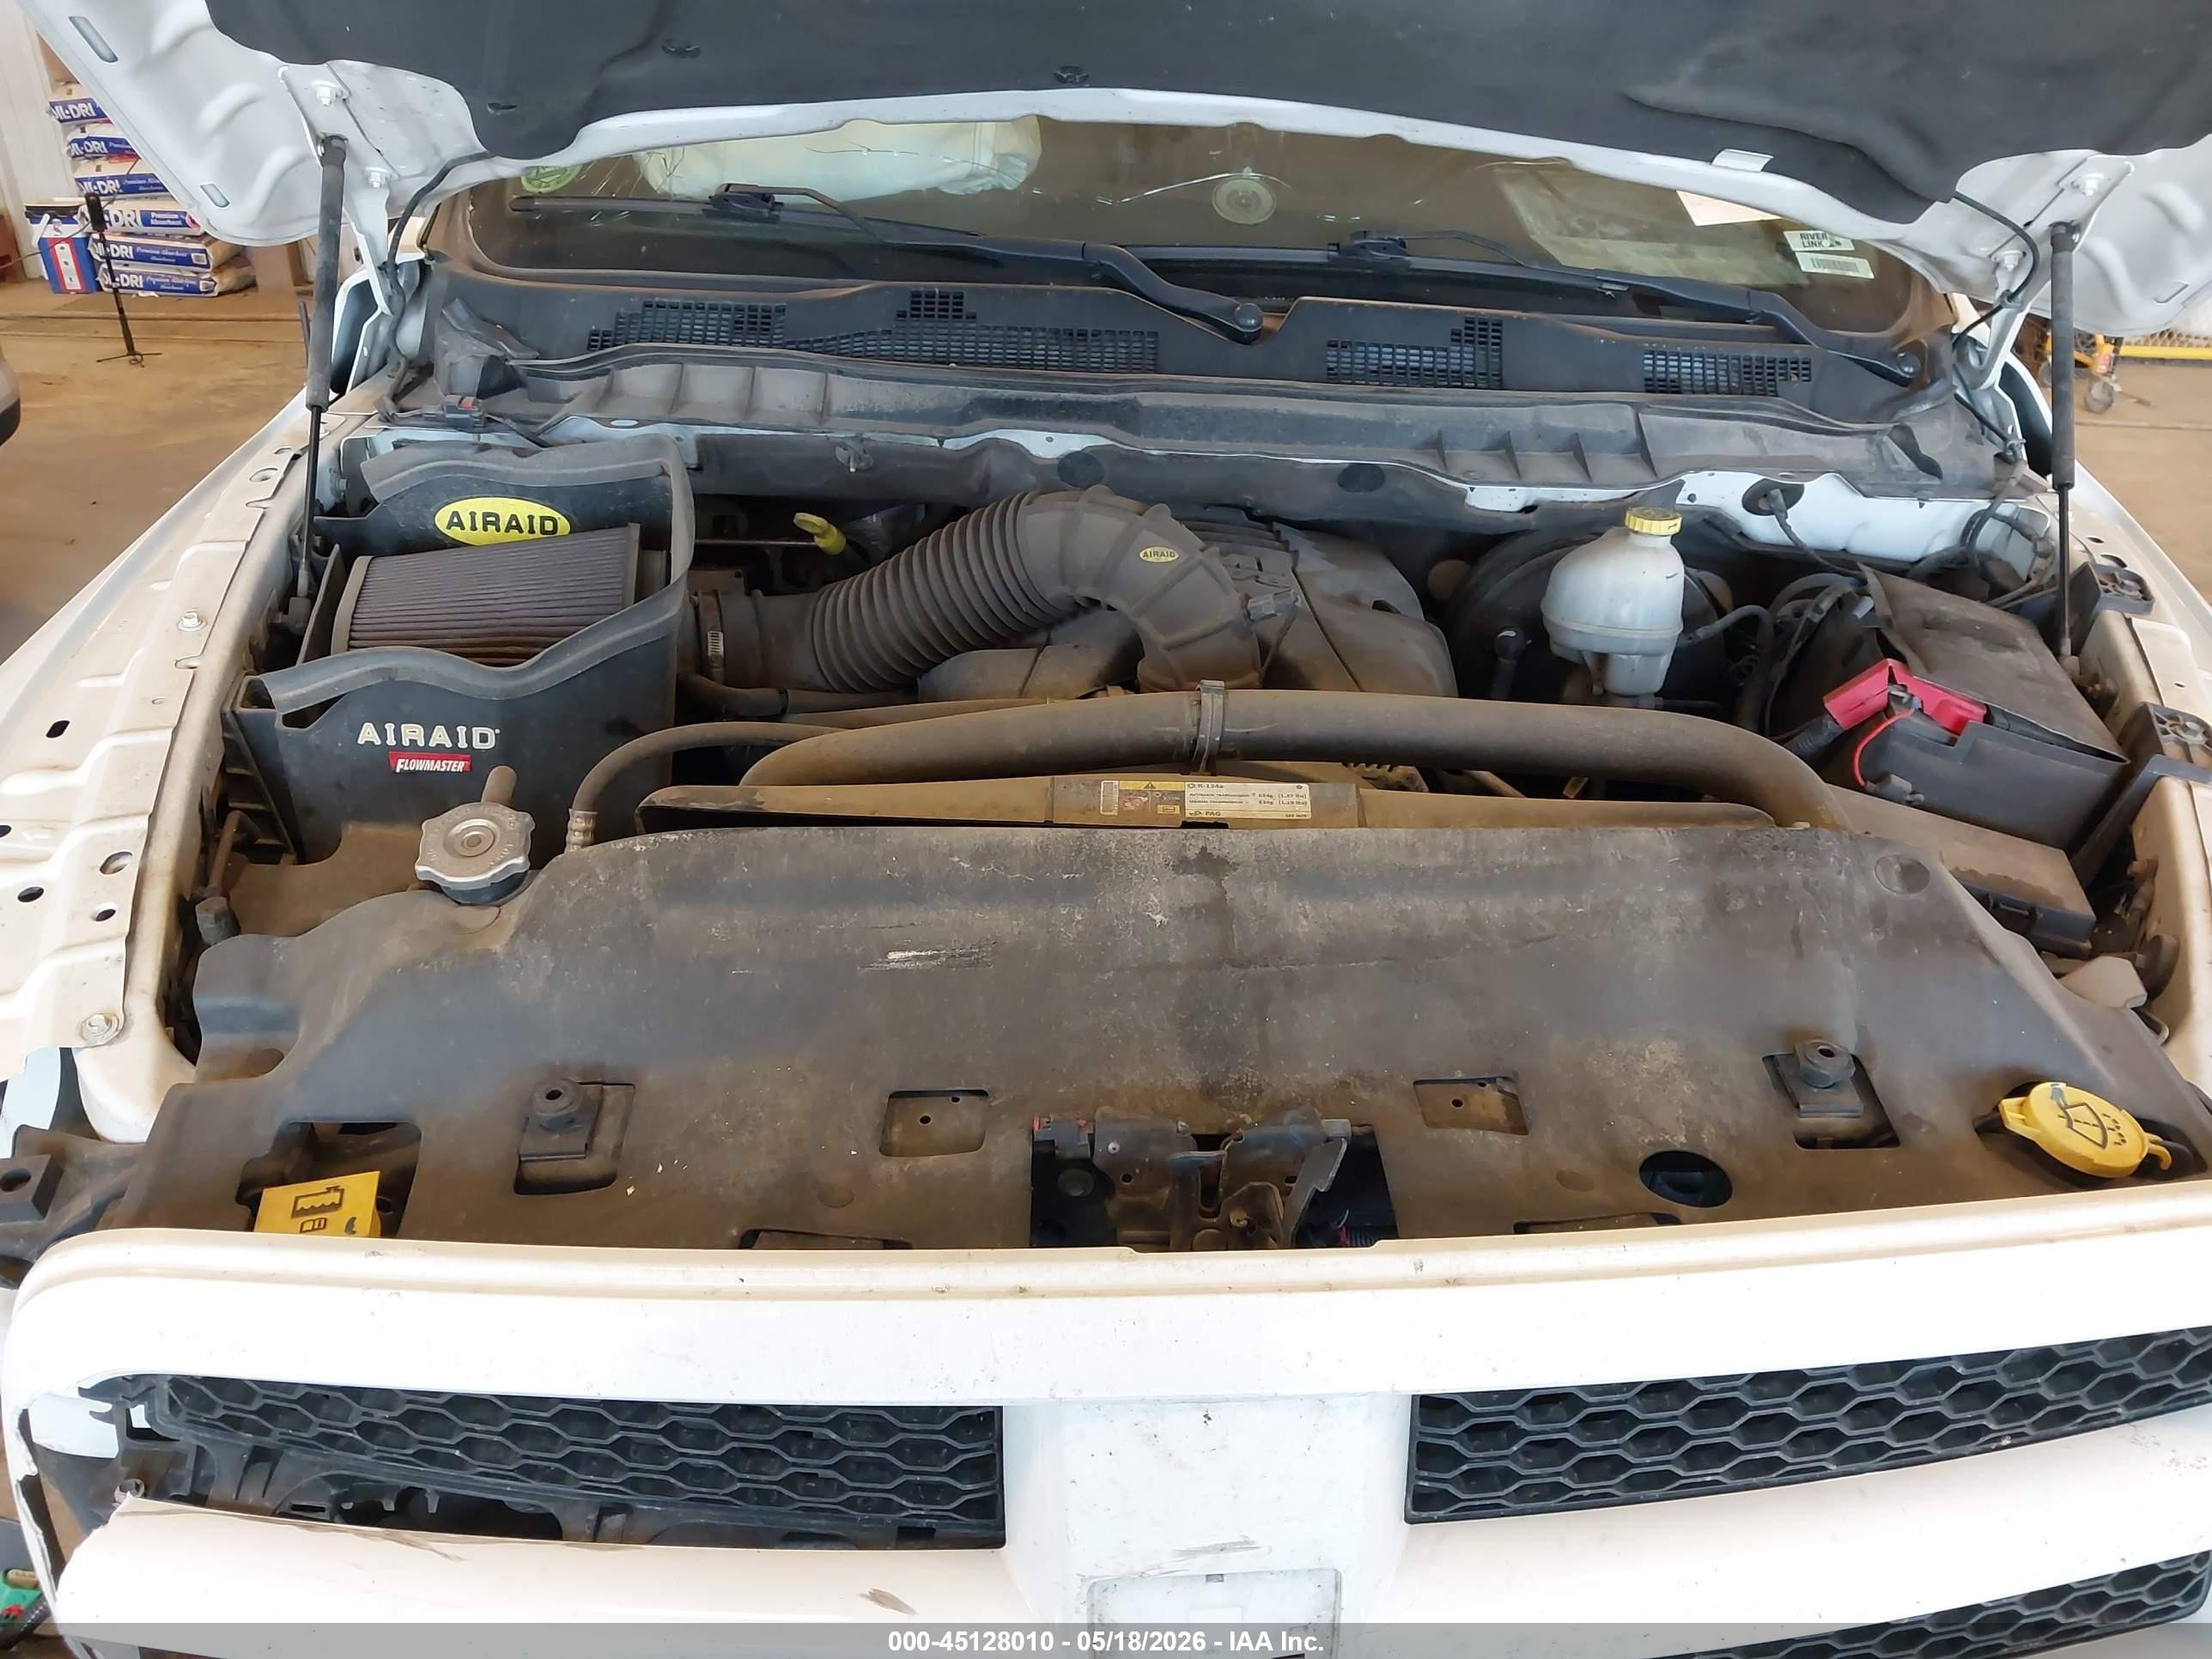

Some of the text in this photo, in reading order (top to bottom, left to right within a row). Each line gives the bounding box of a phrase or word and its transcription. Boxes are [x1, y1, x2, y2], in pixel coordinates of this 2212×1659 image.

[446, 510, 559, 536] AIRAID
[356, 722, 496, 750] AIRAID
[396, 758, 465, 773] FLOWMASTER
